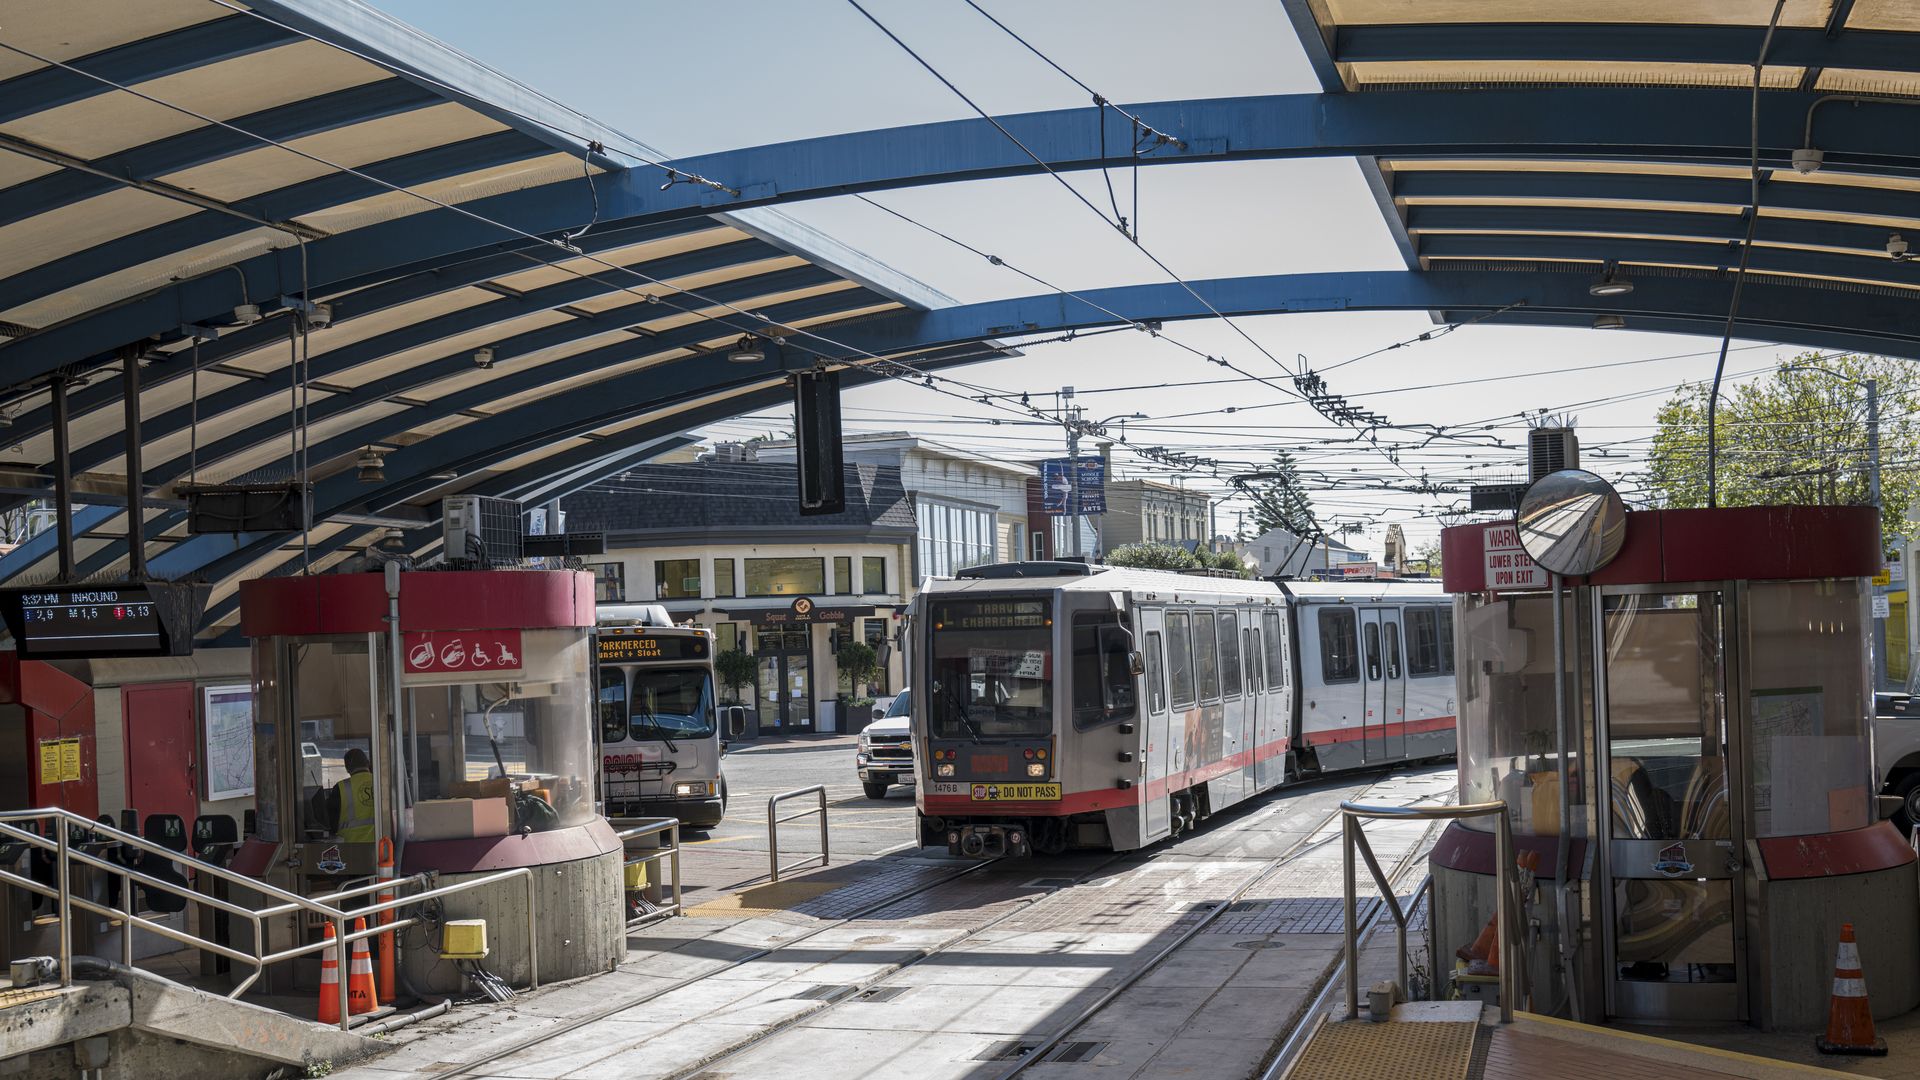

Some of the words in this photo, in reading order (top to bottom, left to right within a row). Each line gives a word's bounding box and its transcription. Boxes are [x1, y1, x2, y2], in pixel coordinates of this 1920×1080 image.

[1489, 529, 1519, 547] WARN
[1489, 555, 1511, 568] LOWER
[1514, 554, 1536, 567] STEP
[1495, 571, 1513, 584] UPON
[1516, 570, 1533, 584] EXIT
[44, 593, 59, 604] PM
[71, 591, 118, 603] INBOUND
[766, 612, 787, 623] Squat
[819, 610, 845, 621] Gobble
[943, 608, 954, 625] L
[962, 616, 1043, 627] EMBARCADERO
[598, 651, 624, 659] unset
[637, 649, 661, 657] Sloat
[974, 786, 986, 797] STOP
[1003, 787, 1015, 798] DO
[1017, 787, 1034, 798] NOT
[1035, 786, 1056, 797] PASS
[350, 990, 366, 998] TA
